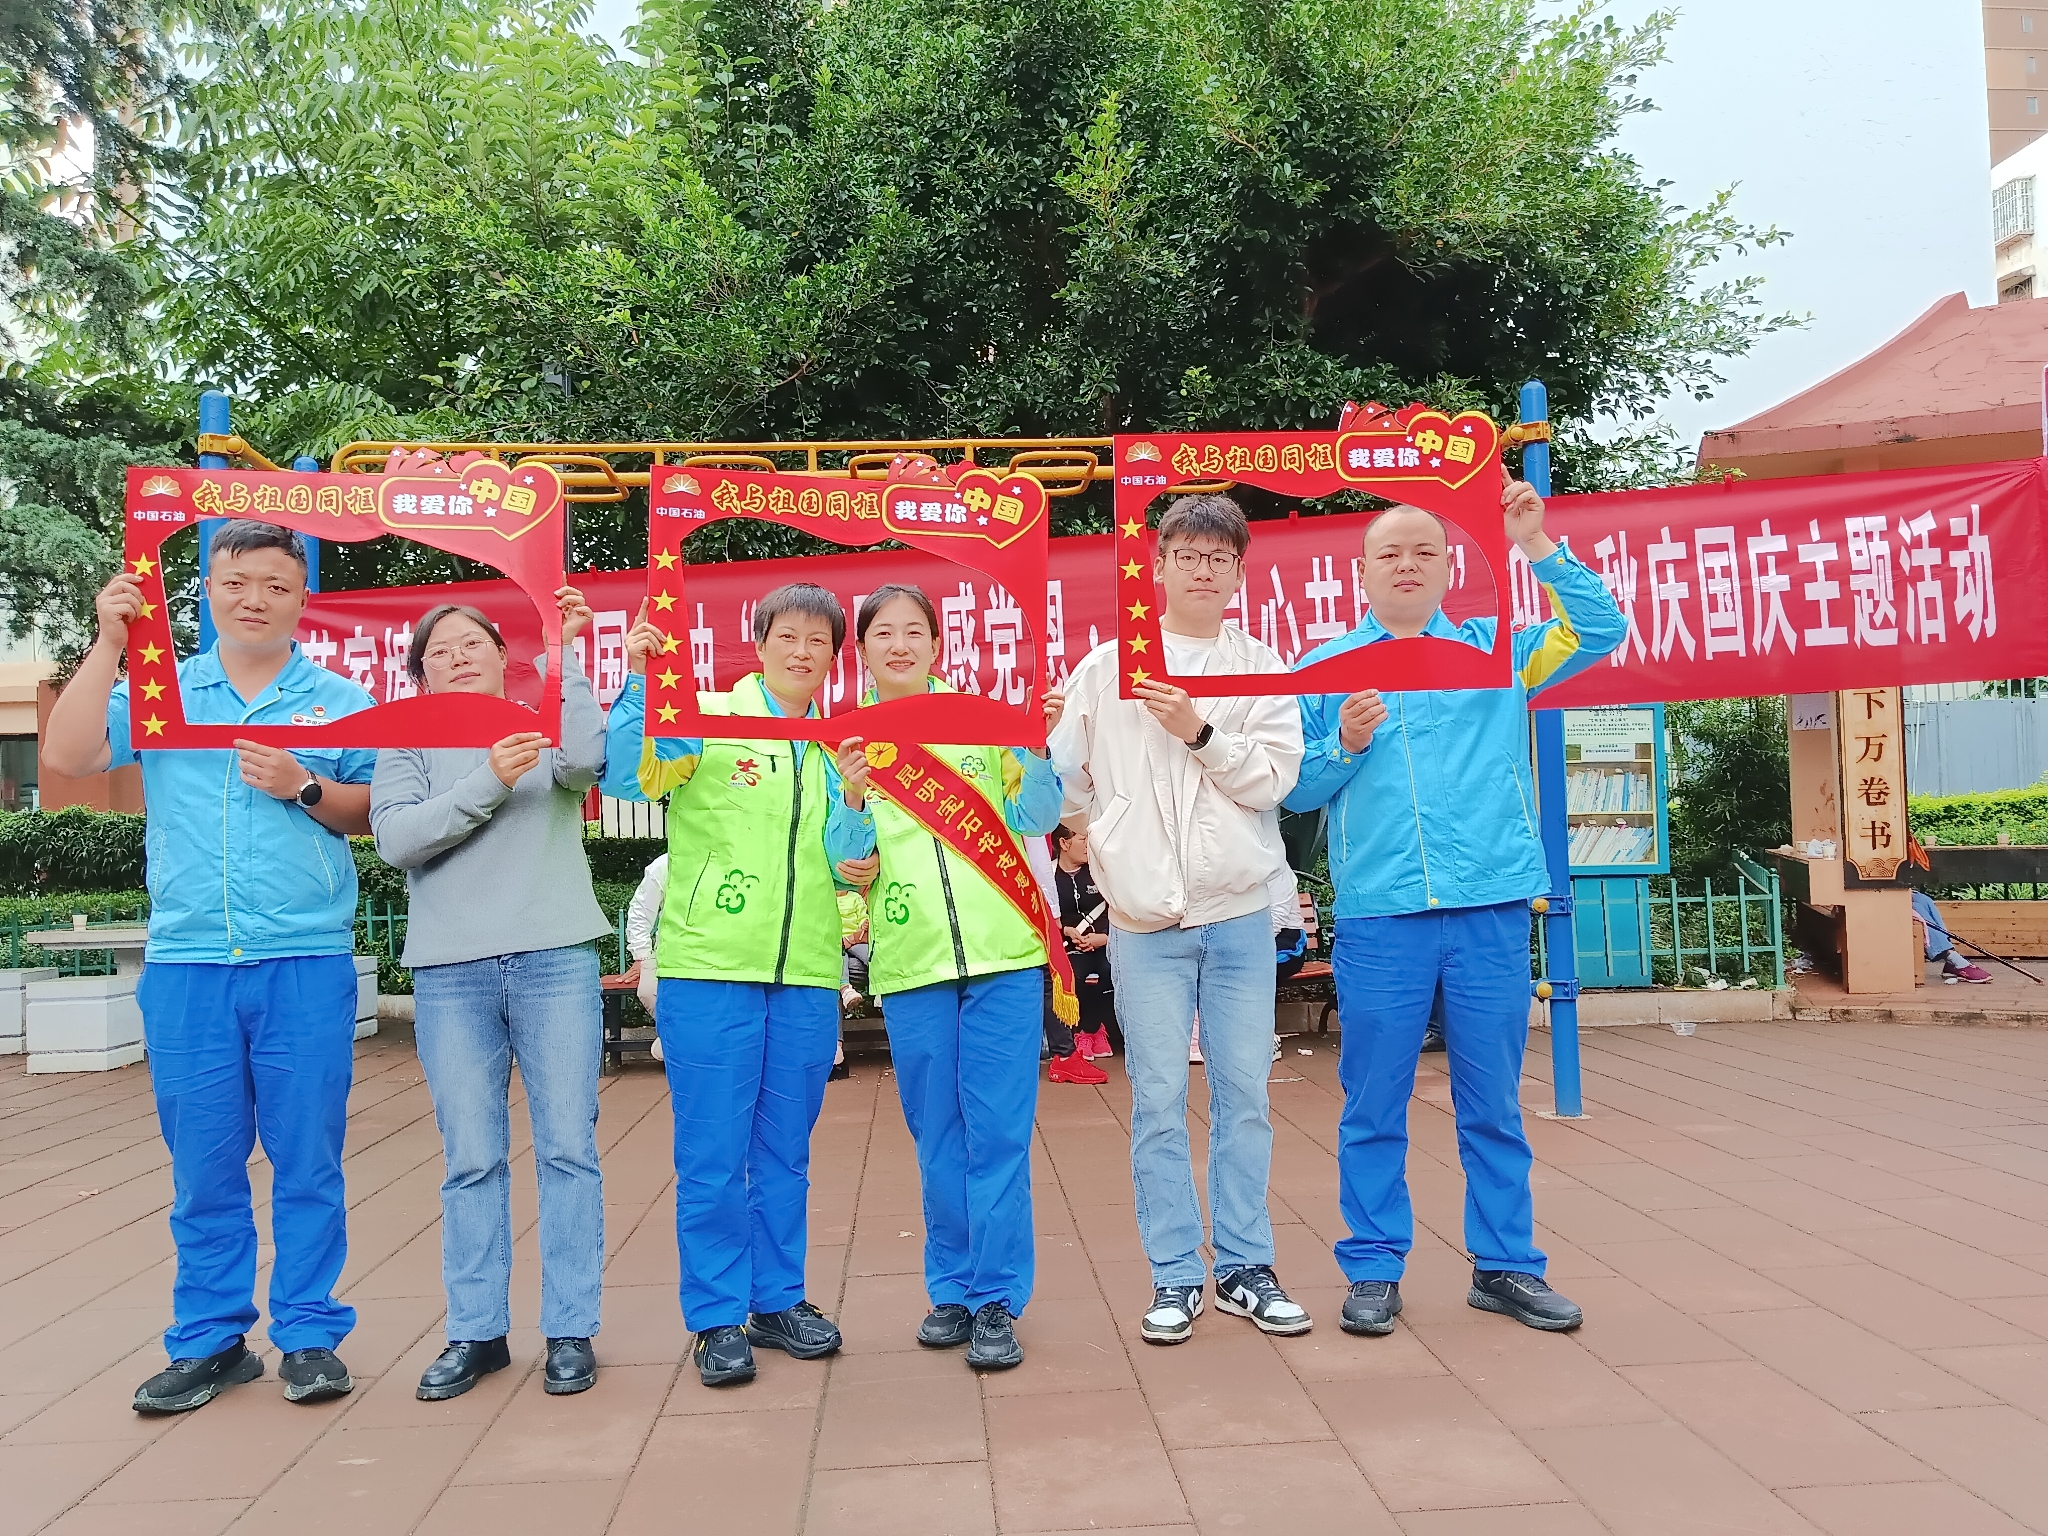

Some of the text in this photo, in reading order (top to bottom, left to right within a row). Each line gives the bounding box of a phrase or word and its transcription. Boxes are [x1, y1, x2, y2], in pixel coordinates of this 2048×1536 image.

[1171, 442, 1336, 476] 我与祖国同框
[1347, 428, 1477, 469] 我爱你 中国
[192, 478, 377, 517] 我与祖国同框
[392, 476, 538, 517] 我爱你 中国
[710, 478, 882, 522] 我与祖国同框
[1120, 474, 1167, 487] 中国石油
[132, 509, 186, 523] 中国石油
[655, 505, 706, 521] 中国石油
[894, 486, 1025, 526] 我爱你 中国
[1852, 689, 1892, 851] 下万卷书
